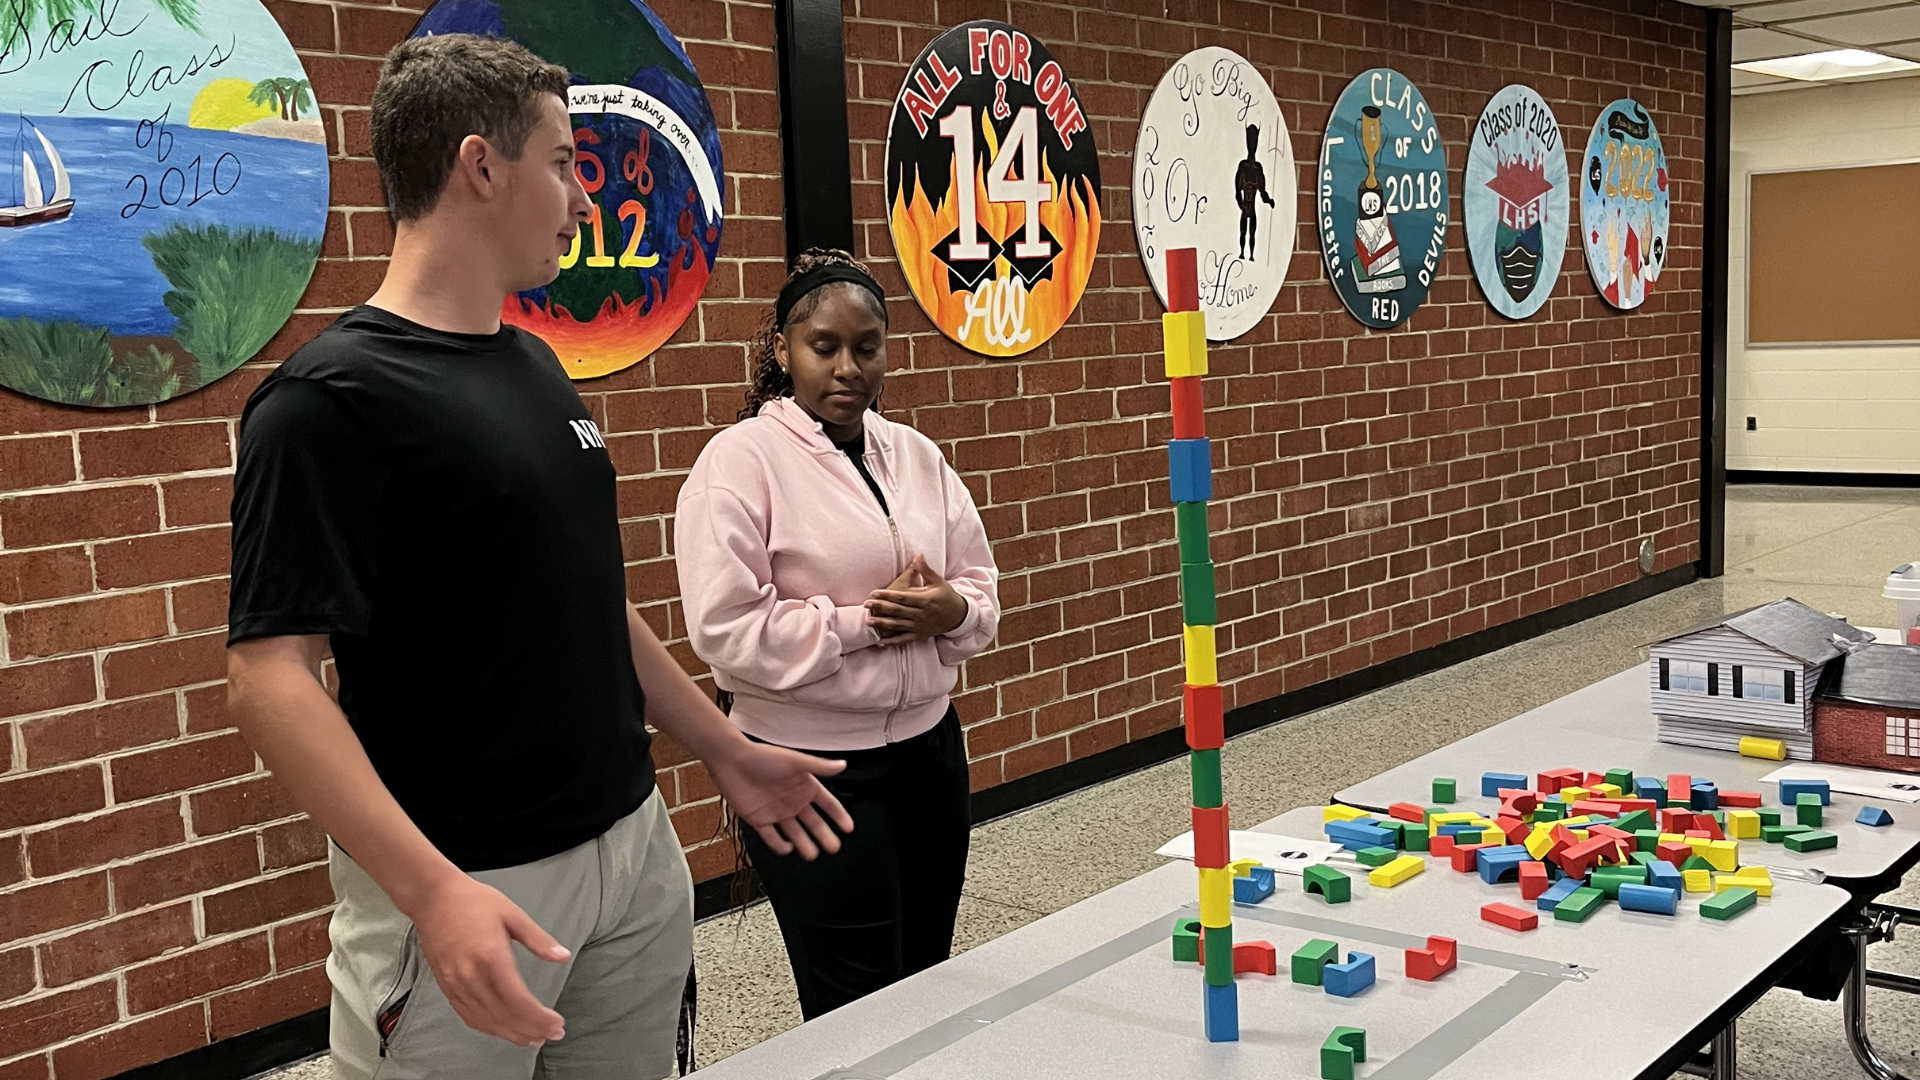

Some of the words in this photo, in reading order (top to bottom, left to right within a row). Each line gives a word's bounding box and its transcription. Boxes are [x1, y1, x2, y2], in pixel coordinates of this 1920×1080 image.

[59, 32, 236, 113] Class
[902, 50, 963, 139] ALL
[968, 28, 1032, 85] FOR
[1034, 60, 1087, 151] ONE
[993, 79, 1012, 120] &
[1173, 63, 1205, 137] Go
[1211, 58, 1260, 122] Big
[136, 102, 174, 163] of
[600, 90, 625, 113] just
[631, 95, 667, 129] taking
[1371, 72, 1437, 154] CLASS
[1480, 105, 1513, 147] Class
[1515, 97, 1527, 128] of
[1529, 103, 1557, 151] 2020
[623, 127, 654, 195] of
[1395, 137, 1412, 158] OF
[1605, 141, 1654, 201] 2022
[121, 152, 242, 219] 2010
[939, 105, 1053, 261] 14
[1165, 158, 1208, 225] Or
[1386, 171, 1441, 213] 2018
[1503, 202, 1538, 230] LHS
[1204, 250, 1258, 308] Home
[1371, 297, 1399, 321] RED
[1418, 212, 1447, 287] DEVILS
[957, 275, 1032, 347] All
